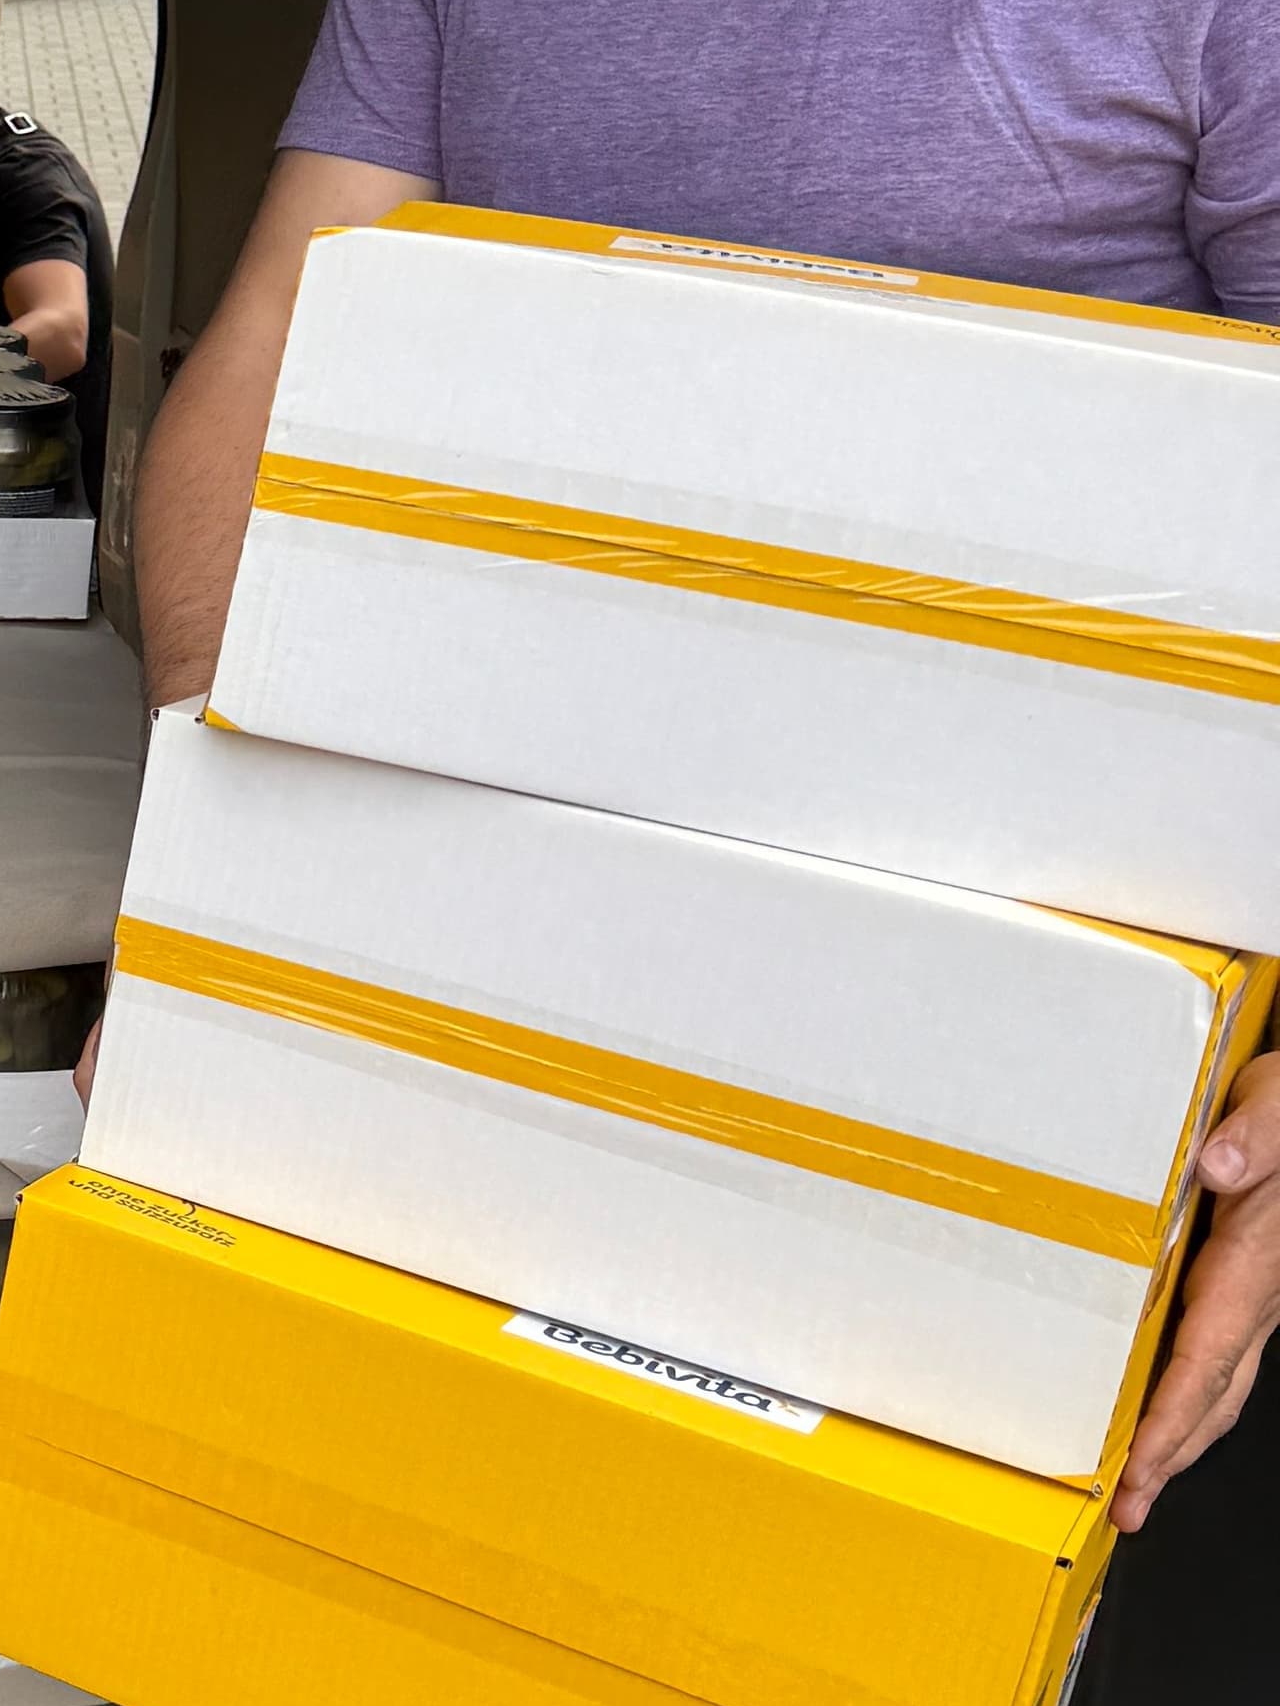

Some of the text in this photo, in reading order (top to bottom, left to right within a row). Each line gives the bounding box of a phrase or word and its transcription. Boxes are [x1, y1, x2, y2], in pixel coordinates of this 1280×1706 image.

[68, 1179, 114, 1201] und
[87, 1180, 146, 1204] ohne
[543, 1321, 771, 1412] Bebivita
